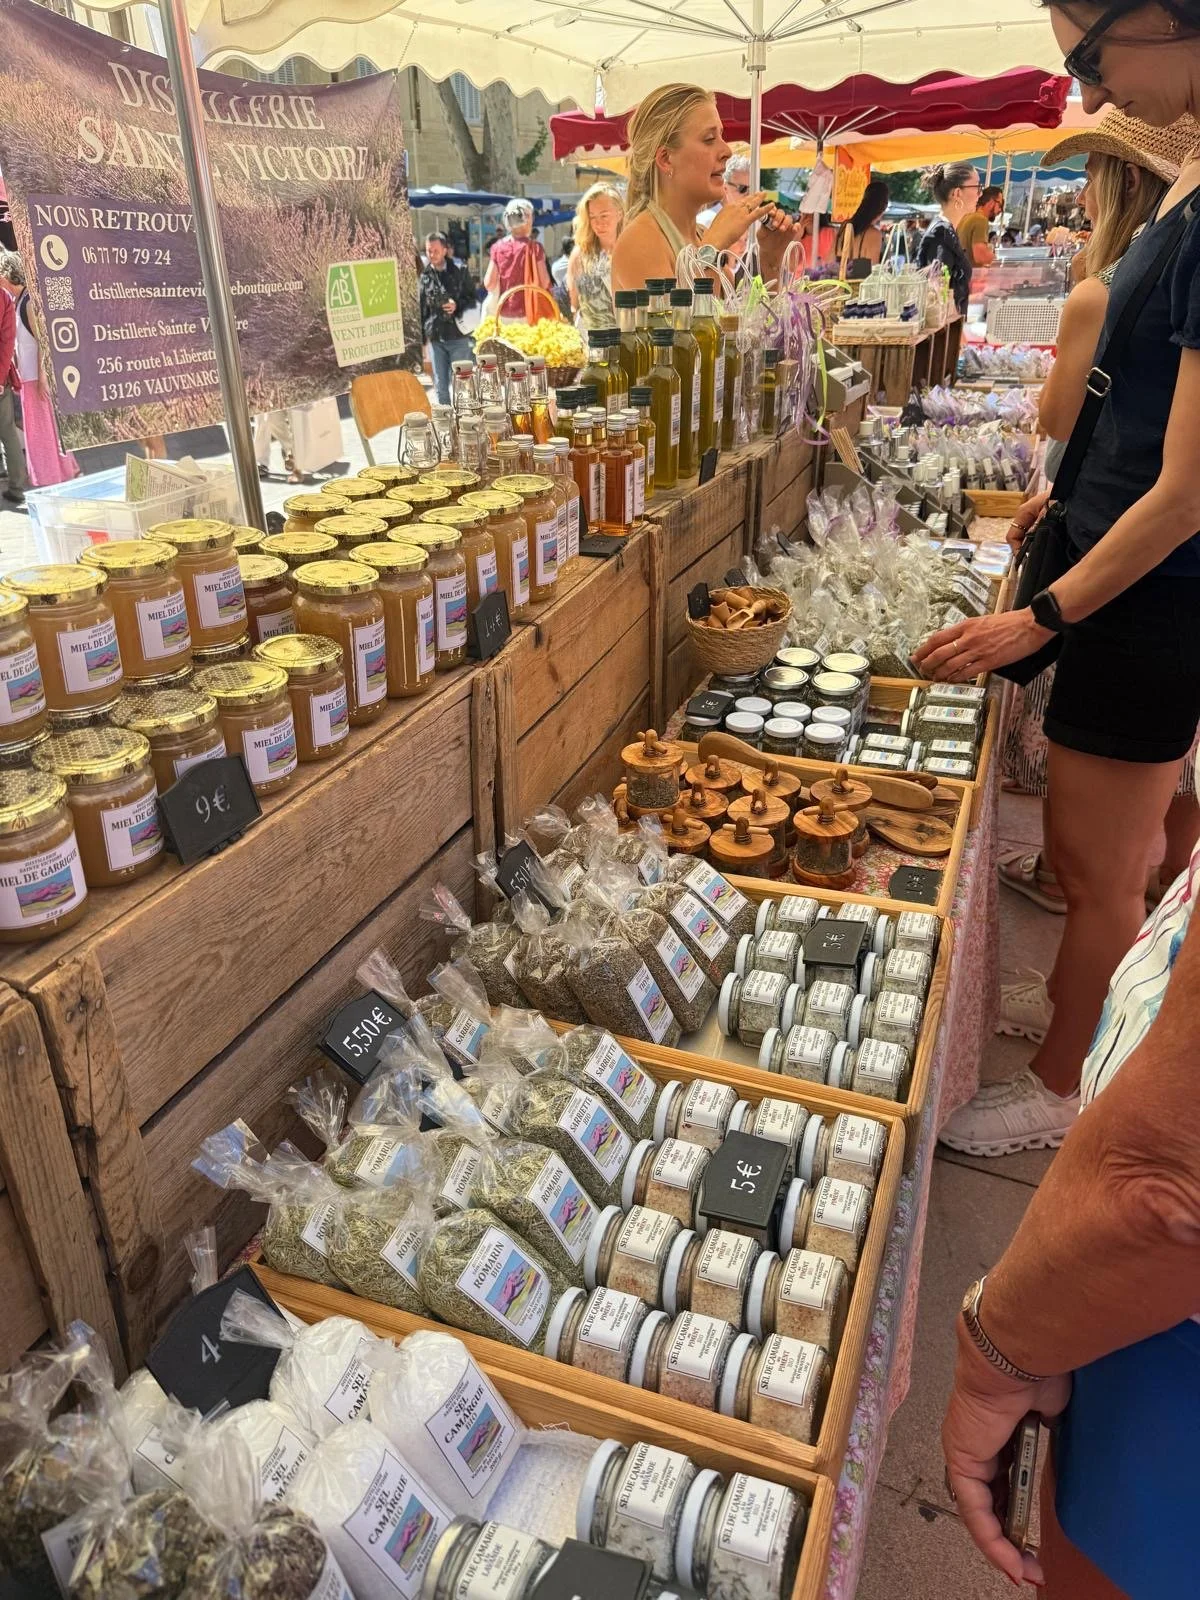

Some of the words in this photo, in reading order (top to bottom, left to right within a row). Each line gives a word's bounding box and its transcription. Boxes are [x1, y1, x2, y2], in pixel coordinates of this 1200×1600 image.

[107, 62, 325, 130] DISILLERIE
[225, 143, 369, 182] VICTOIRE
[34, 204, 90, 228] NOUS
[90, 207, 197, 234] RETROUV
[81, 246, 98, 264] 06
[99, 246, 111, 264] 77
[112, 247, 128, 265] 79
[133, 248, 151, 265] 79
[154, 248, 172, 266] 24
[93, 320, 158, 342] Distillerie
[158, 318, 197, 336] Sainte
[333, 325, 368, 342] VENTE
[369, 318, 402, 337] DIRECTE
[342, 337, 401, 361] PRODUCTEURS
[97, 356, 123, 374] 256
[126, 354, 161, 372] route
[162, 350, 173, 363] la
[100, 381, 141, 402] 13126
[204, 583, 223, 593] MIEL
[147, 610, 167, 621] MIEL
[70, 642, 93, 654] MIEL
[93, 639, 102, 649] DE
[13, 667, 24, 677] DE
[253, 738, 274, 750] MIEL
[111, 818, 135, 832] MIEL
[135, 812, 146, 823] DE
[23, 871, 39, 884] DE
[595, 1042, 617, 1077] SARRIETTE
[570, 1096, 592, 1133] SARRIETTE
[455, 1156, 479, 1196] ROMARIN
[540, 1167, 564, 1204] ROMARIN
[730, 1160, 762, 1194] 5€
[473, 1241, 505, 1289] ROMARIN
[490, 1261, 502, 1279] BIO
[582, 1323, 591, 1337] SEL
[670, 1351, 680, 1365] SEL
[351, 1373, 366, 1394] SEL
[760, 1375, 771, 1390] SEL
[444, 1384, 484, 1444] CAMARGUE
[453, 1396, 469, 1417] SEL
[465, 1412, 478, 1430] BIO
[270, 1462, 288, 1486] SEL
[640, 1460, 657, 1491] LAVANDE
[625, 1480, 636, 1493] DE
[368, 1474, 408, 1545] CAMARGUE
[374, 1489, 391, 1512] SEL
[619, 1488, 632, 1509] SEL
[741, 1491, 757, 1525] LAVANDE
[390, 1507, 404, 1528] BIO
[727, 1514, 737, 1528] DE
[721, 1525, 734, 1545] SEL
[481, 1543, 500, 1578] LAVANDE
[458, 1573, 473, 1597] SEL
[466, 1562, 478, 1582] DE
